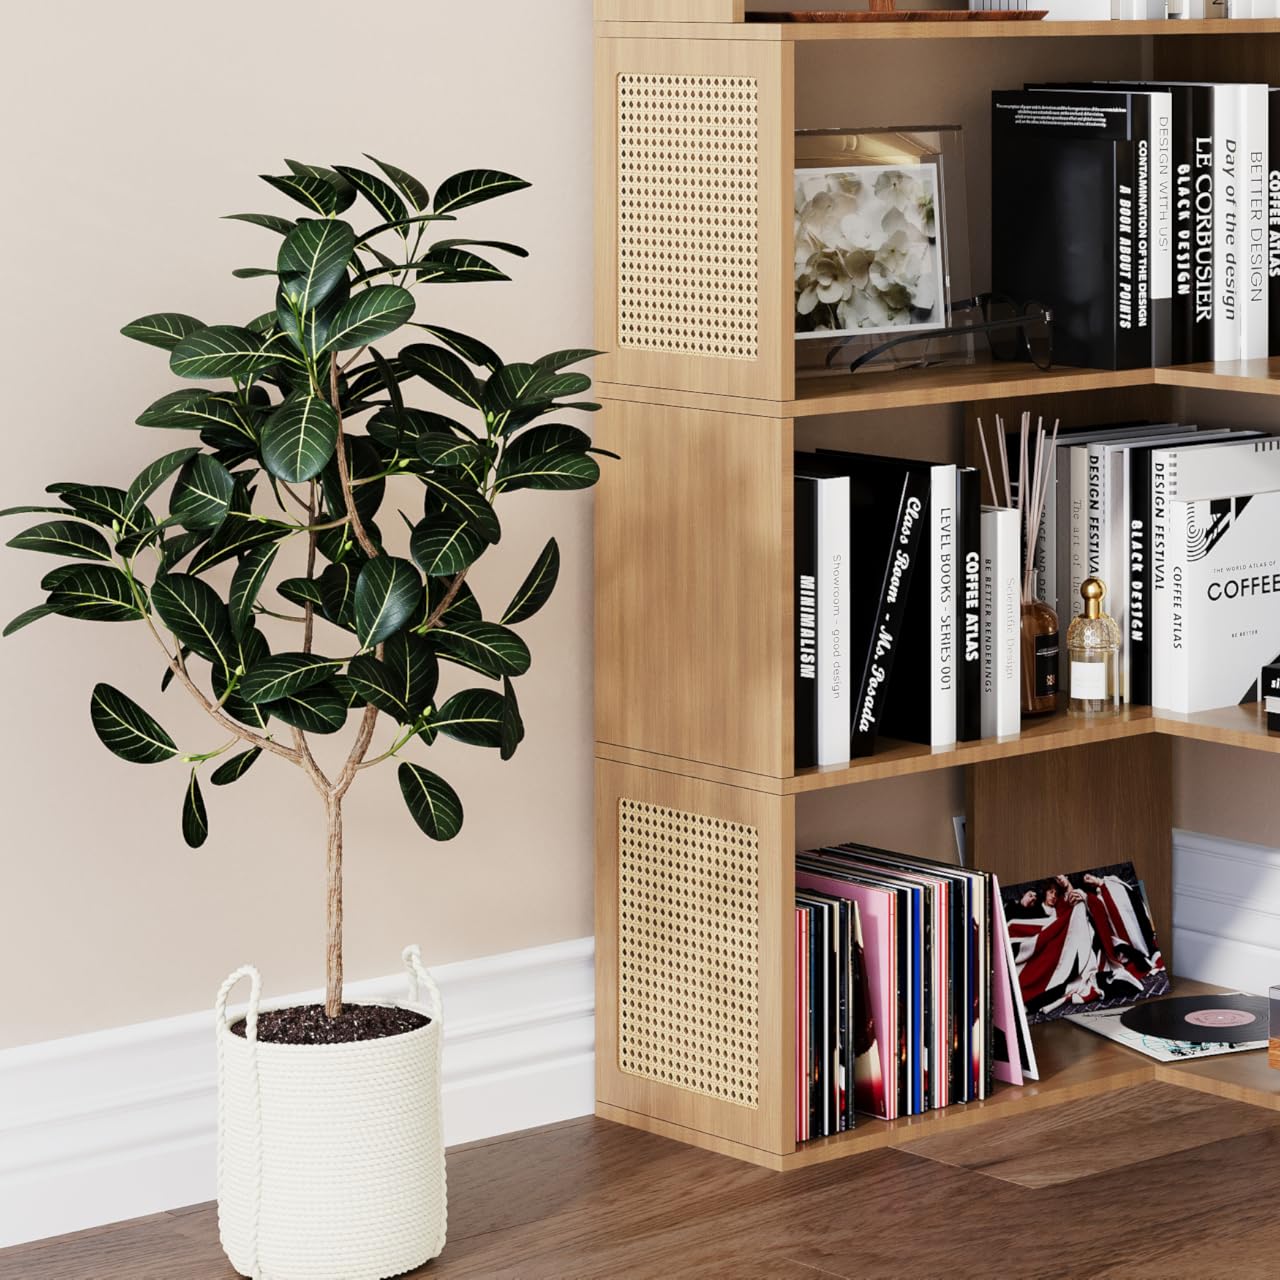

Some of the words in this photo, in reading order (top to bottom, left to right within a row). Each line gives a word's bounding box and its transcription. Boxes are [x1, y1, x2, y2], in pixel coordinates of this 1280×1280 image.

[1159, 116, 1169, 175] DESIGN
[1195, 135, 1213, 168] LE
[1222, 138, 1237, 178] Day
[1119, 184, 1131, 194] A
[1138, 139, 1148, 239] CONTAMINATION
[1159, 179, 1169, 220] WITH
[1177, 163, 1191, 221] BLACK
[1225, 184, 1237, 205] of
[1250, 152, 1263, 221] BETTER
[1119, 200, 1131, 233] BOOK
[1159, 226, 1169, 252] US!
[1225, 211, 1238, 246] the
[1119, 238, 1131, 278] ABOUT
[1138, 242, 1148, 255] OF
[1138, 256, 1148, 280] THE
[1177, 229, 1191, 295] DESIGN
[1195, 174, 1213, 324] CORBUSIER
[1250, 228, 1263, 302] DESIGN
[1119, 283, 1131, 329] POINTS
[1138, 283, 1148, 328] DESIGN
[1222, 253, 1237, 321] design
[1089, 455, 1099, 511] DESIGN
[1155, 463, 1164, 518] DESIGN
[899, 496, 922, 545] Class
[940, 507, 951, 549] LEVEL
[1073, 499, 1082, 520] The
[1073, 527, 1082, 546] art
[1131, 520, 1143, 572] BLACK
[1155, 525, 1164, 590] FESTIVAL
[832, 554, 842, 616] Showroom
[886, 549, 910, 603] Room
[940, 553, 951, 603] BOOKS
[965, 551, 980, 609] COFFEE
[985, 558, 991, 572] BE
[1073, 576, 1082, 595] the
[1173, 565, 1182, 609] COFFEE
[1225, 564, 1247, 573] WORLD
[1248, 561, 1268, 570] ATLAS
[800, 575, 815, 679] MINIMALISM
[1131, 581, 1143, 641] DESIGN
[1173, 612, 1182, 650] ATLAS
[831, 629, 842, 657] good
[940, 615, 951, 663] SERIES
[965, 613, 979, 662] ATLAS
[831, 661, 841, 699] design
[859, 663, 886, 733] Posada
[940, 666, 951, 692] 001
